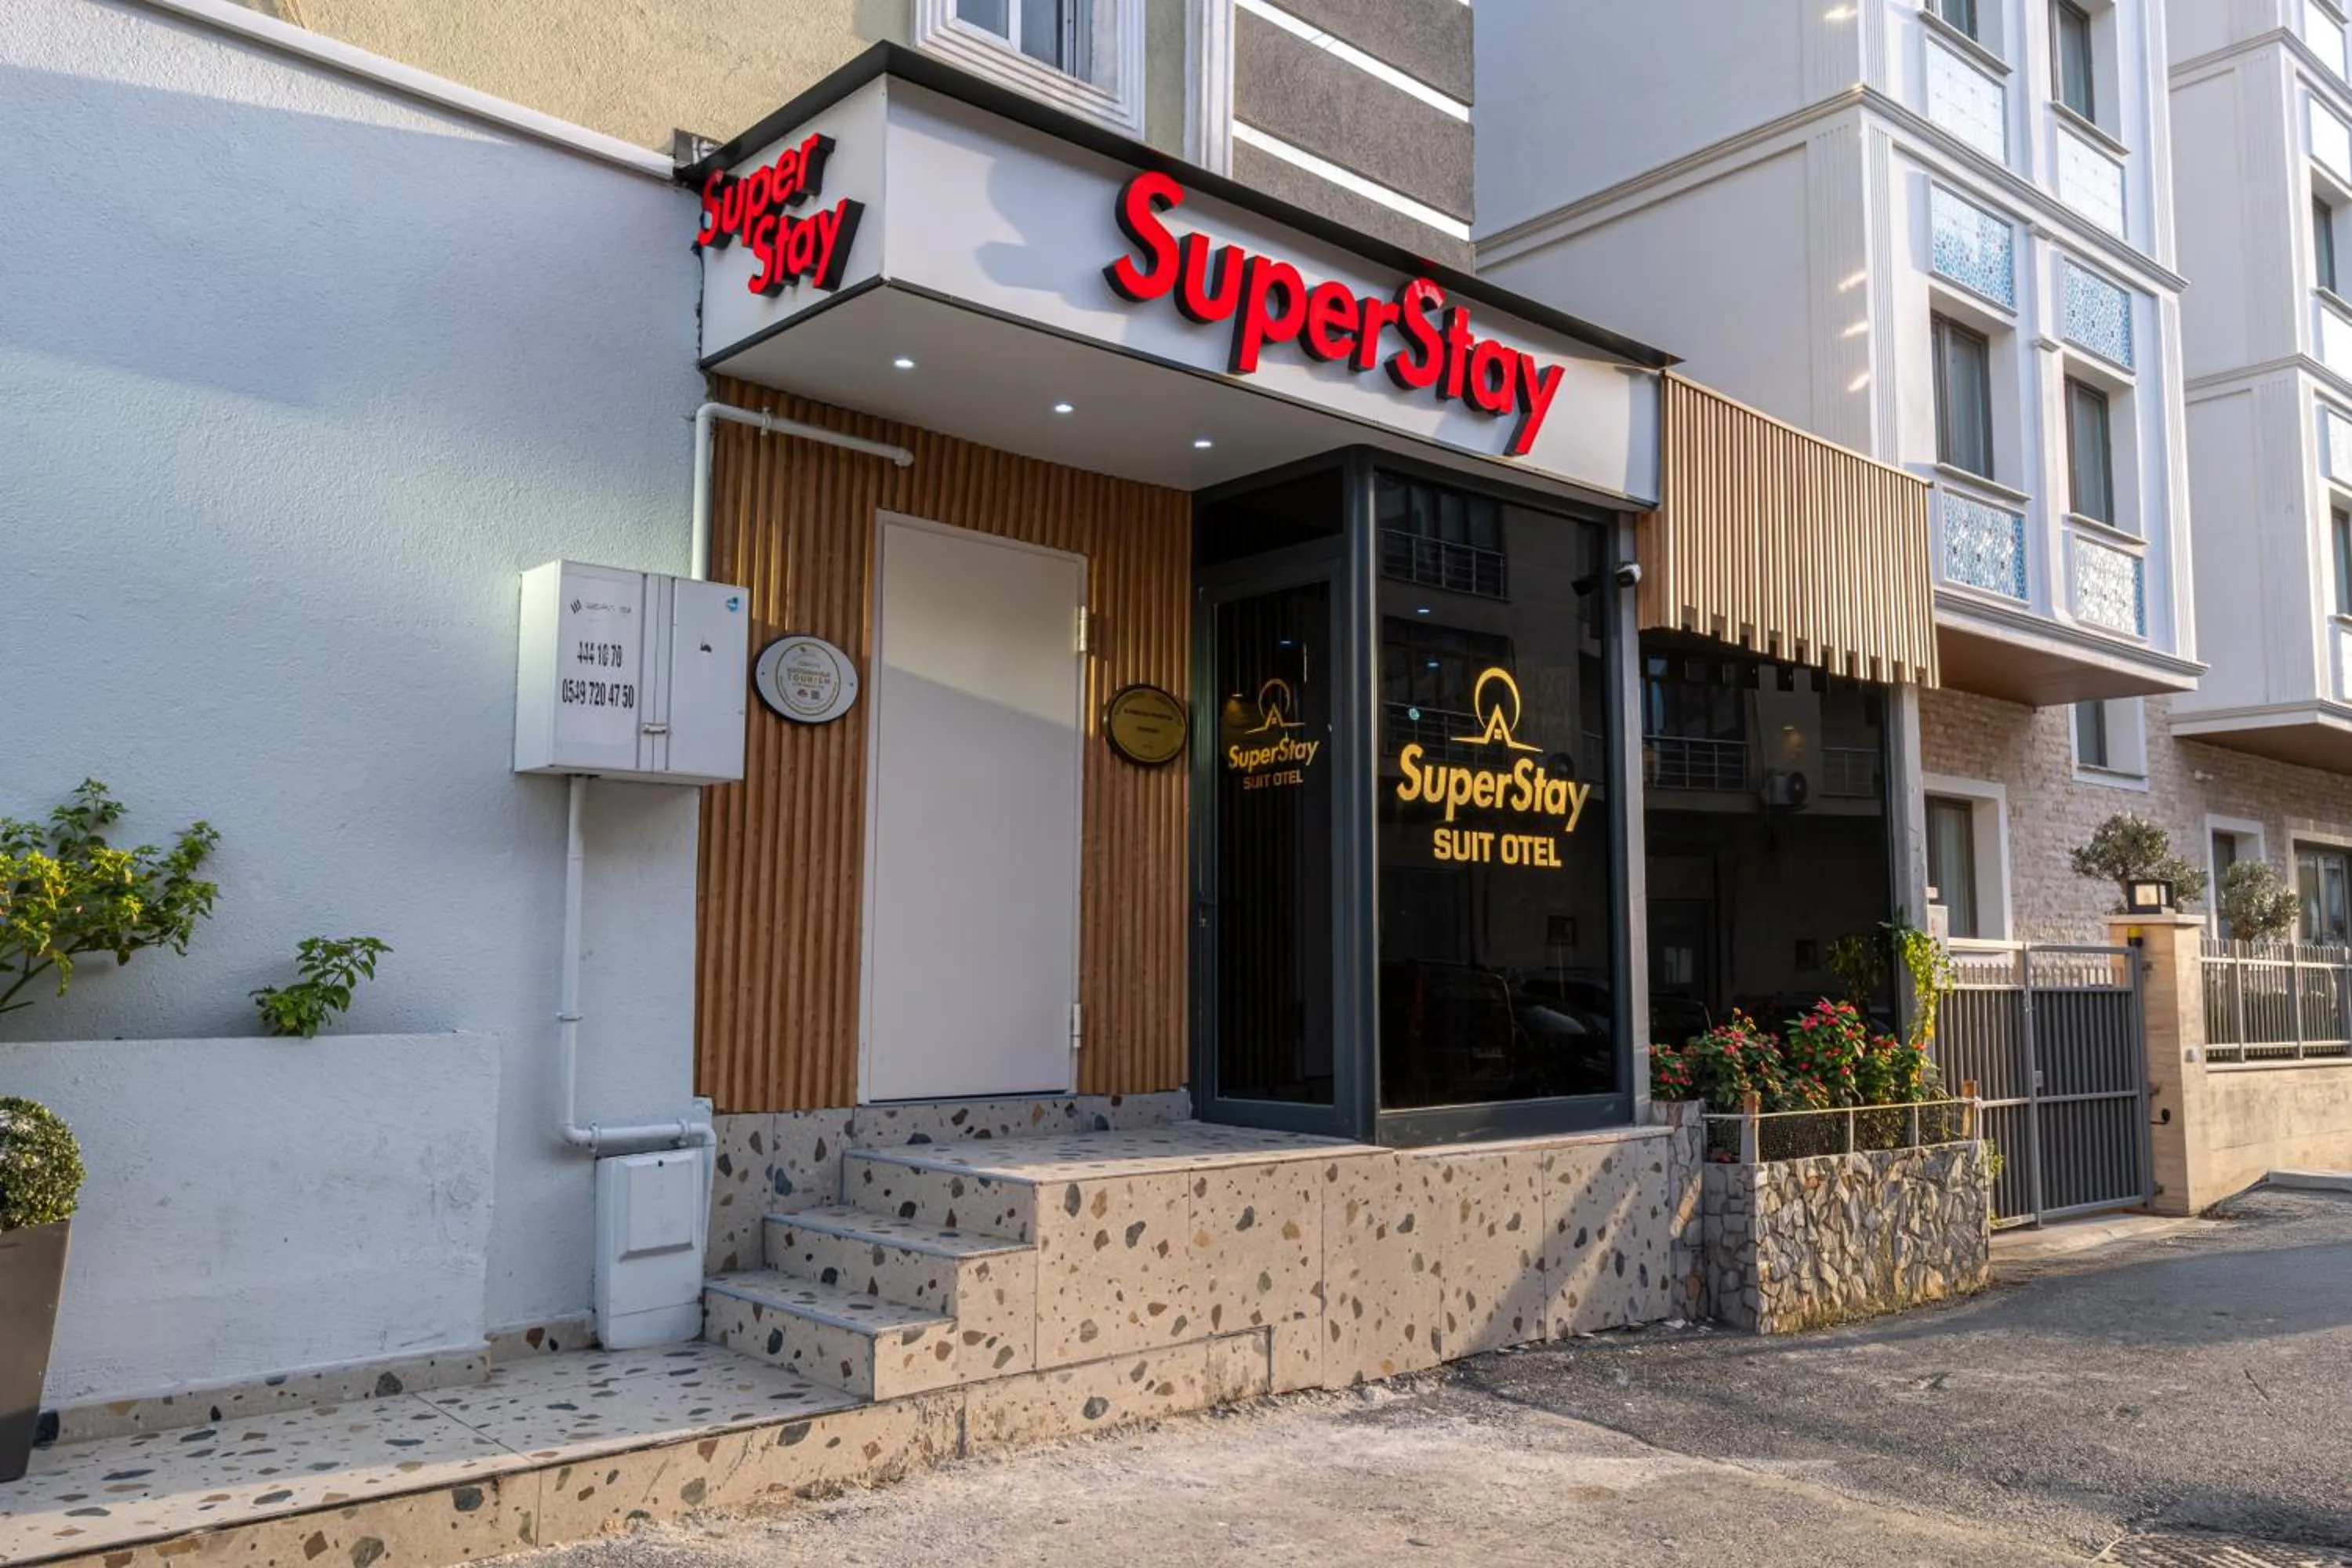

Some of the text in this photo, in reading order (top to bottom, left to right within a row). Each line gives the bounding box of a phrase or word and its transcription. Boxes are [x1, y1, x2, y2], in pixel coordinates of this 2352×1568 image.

[698, 132, 833, 249] Super
[748, 198, 862, 296] Stay
[1104, 171, 1565, 455] SuperStay
[577, 640, 623, 668] 444 10 70
[561, 677, 635, 709] 0549 720 47 50
[1228, 735, 1319, 774] SuperStay
[1243, 769, 1304, 790] SUIT OTEL
[1396, 744, 1592, 832] SuperStay
[1434, 828, 1562, 866] SUIT OTEL
